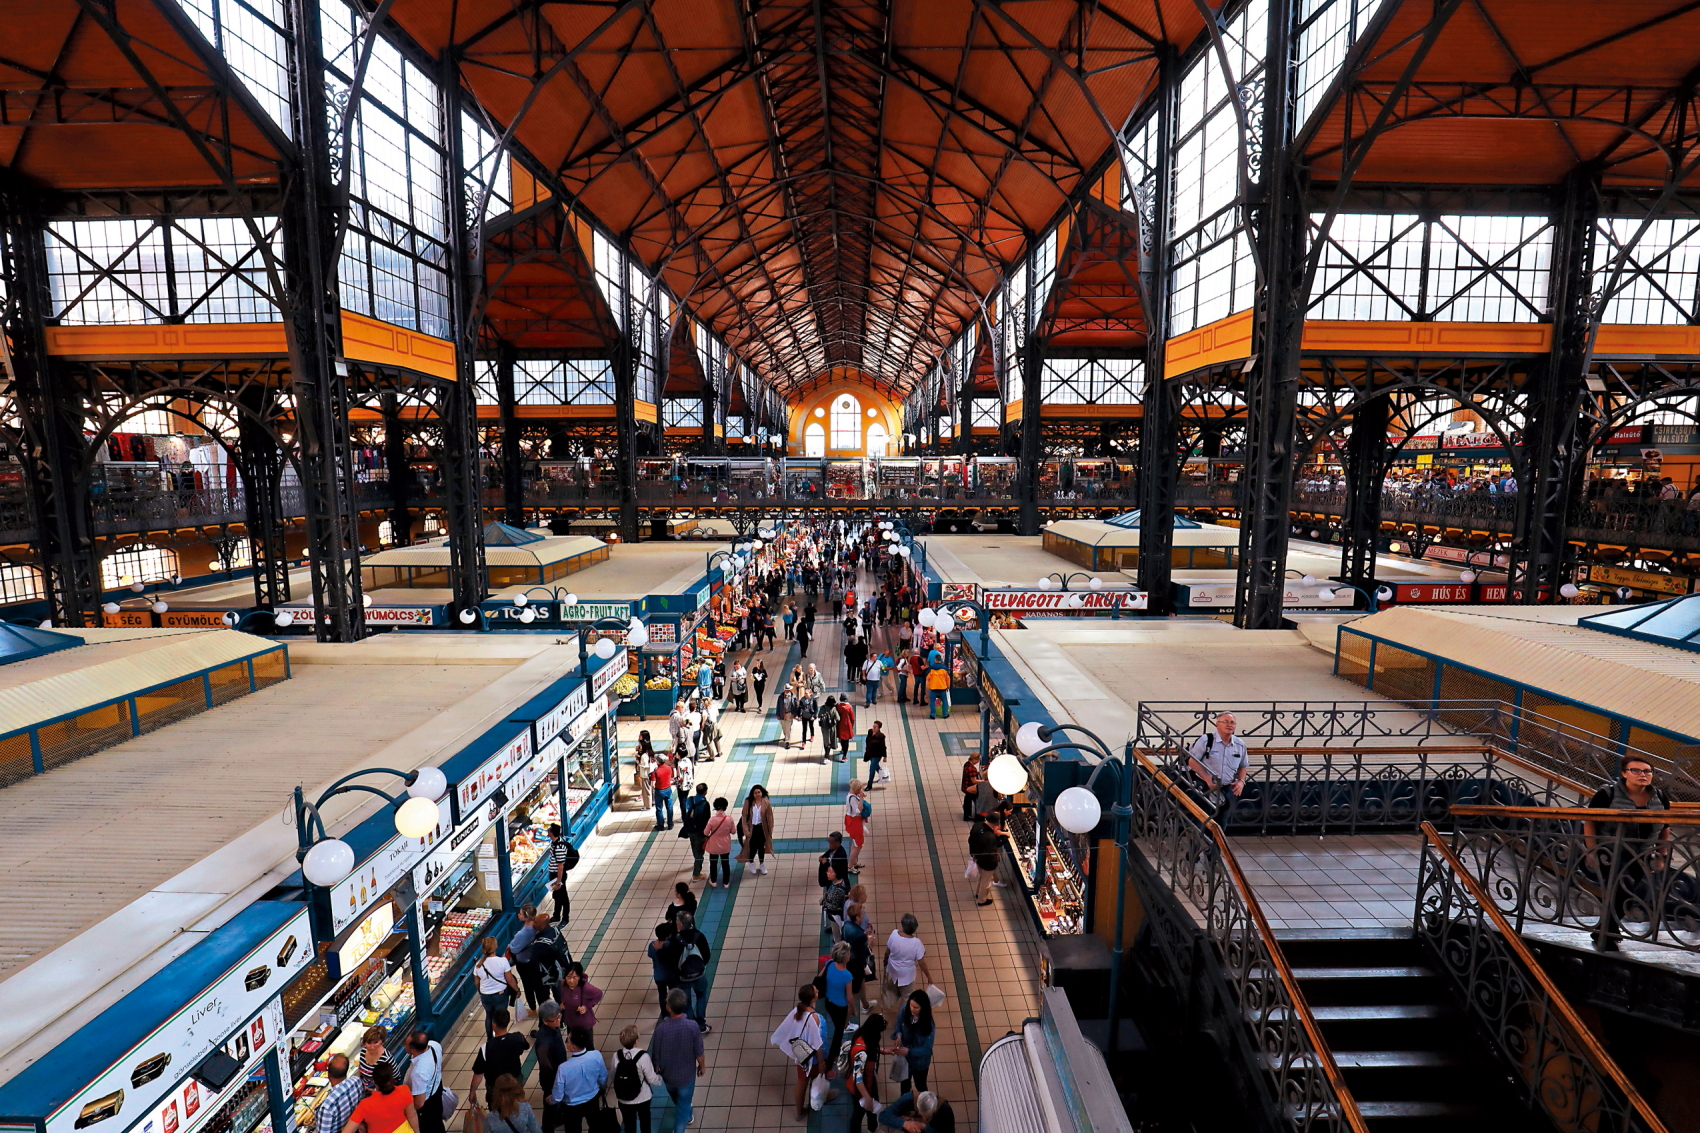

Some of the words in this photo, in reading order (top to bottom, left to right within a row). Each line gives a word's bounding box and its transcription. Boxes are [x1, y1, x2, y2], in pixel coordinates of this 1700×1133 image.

[985, 592, 1064, 609] FELVÁGOTT
[1432, 586, 1451, 600] HÚS
[1455, 586, 1466, 600] ÉS
[502, 604, 549, 619] TOÁS
[563, 605, 612, 619] AGRO-FRUIT
[614, 606, 630, 619] KFT.
[456, 819, 479, 844] UNICUM
[389, 840, 408, 861] TOKAJI
[352, 922, 385, 962] TOKAJI
[191, 997, 218, 1025] Liver
